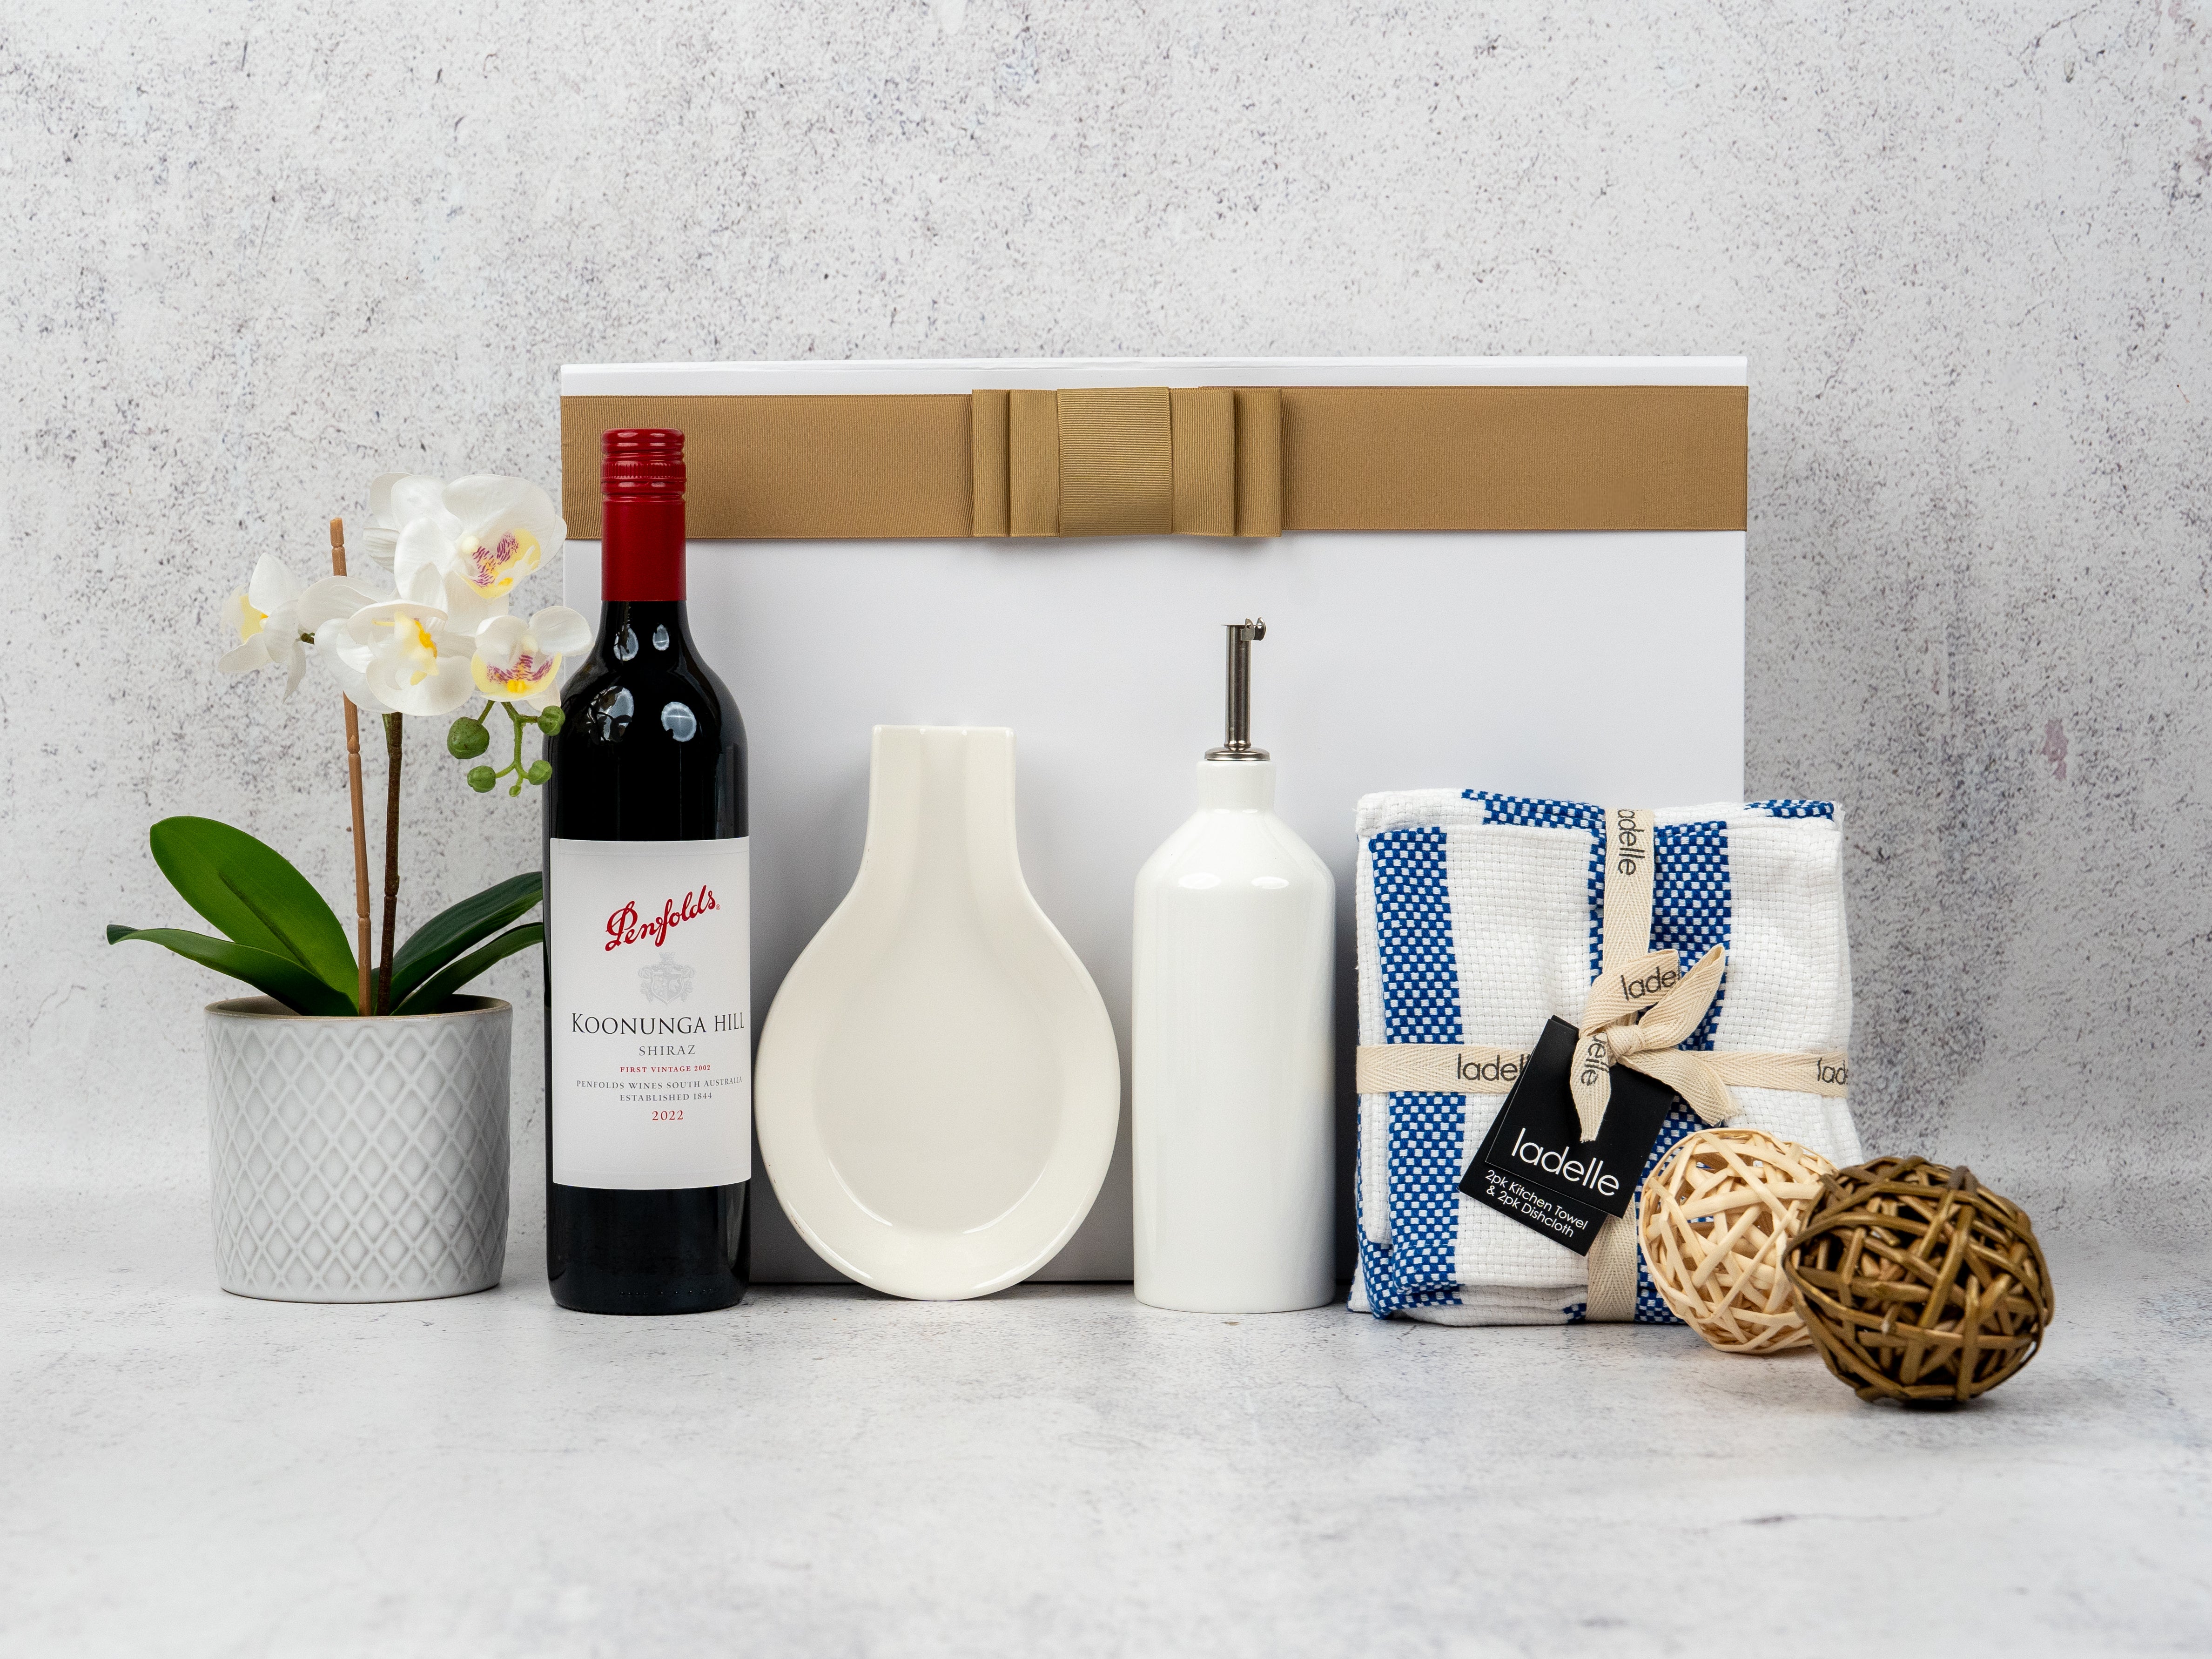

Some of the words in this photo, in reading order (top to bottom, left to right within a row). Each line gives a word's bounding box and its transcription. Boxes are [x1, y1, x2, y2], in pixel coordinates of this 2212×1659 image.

[1617, 809, 1645, 876] adelle
[571, 1012, 707, 1035] KOONUNGA
[714, 1012, 745, 1032] HILL
[639, 1045, 696, 1056] SHIRAZ
[1458, 1053, 1531, 1081] ladel
[577, 1080, 624, 1089] PENFOLDS
[666, 1080, 700, 1089] SOUTH
[703, 1076, 743, 1087] AUSTRALIA
[652, 1110, 684, 1121] 2022
[1512, 1127, 1620, 1196] ladelle
[1485, 1170, 1508, 1188] 2pk
[1509, 1181, 1552, 1212] Kitchen
[1555, 1205, 1588, 1230] Towel
[1486, 1185, 1495, 1196] &
[1498, 1191, 1520, 1209] 2pk
[1521, 1202, 1574, 1237] Dishcloth
